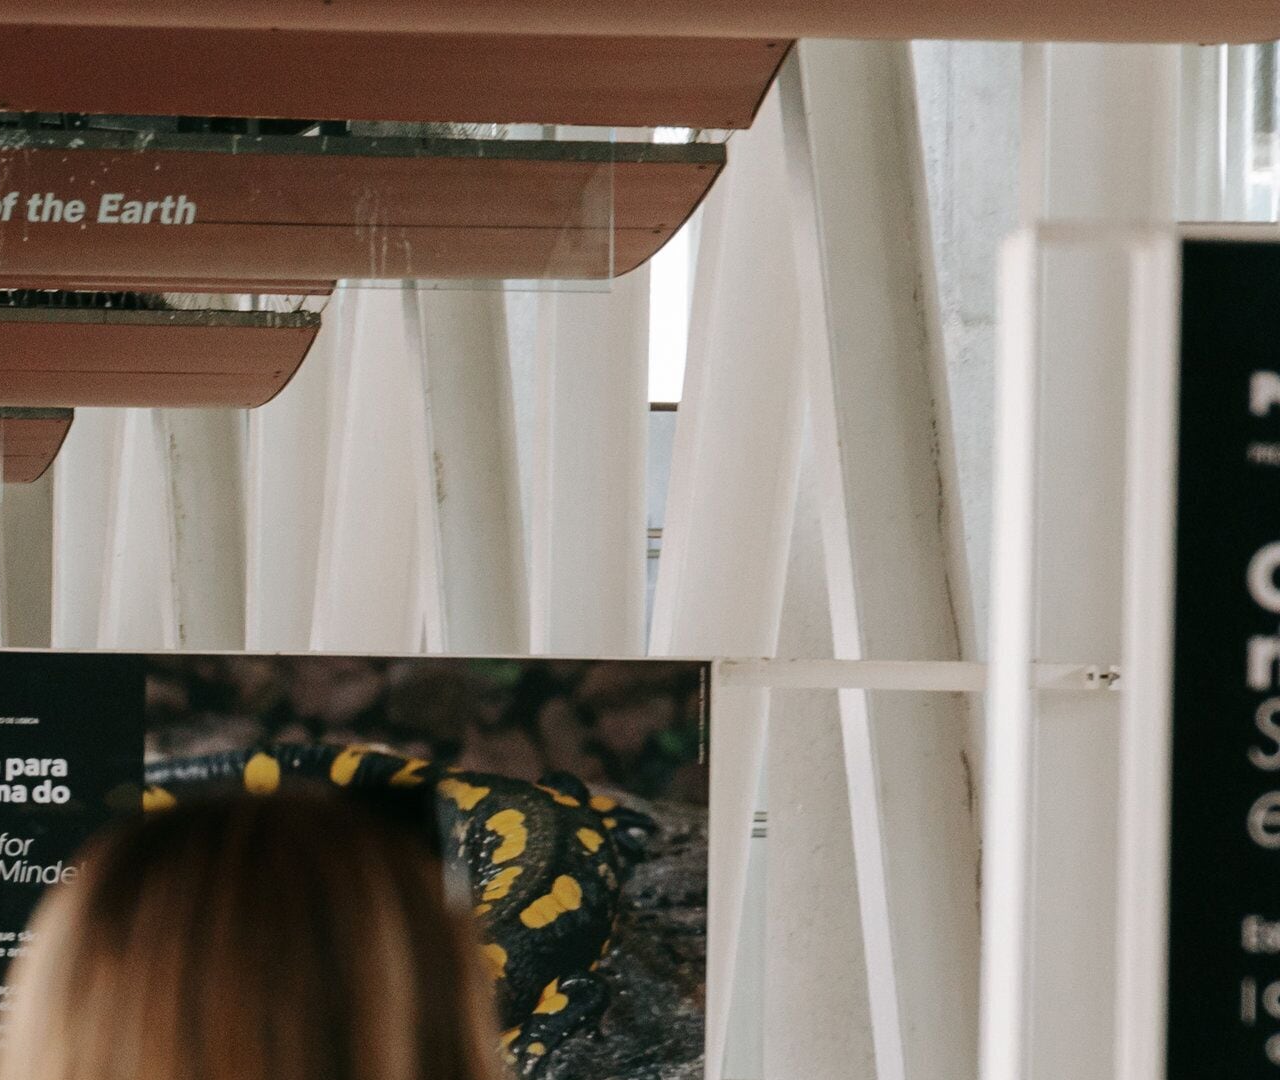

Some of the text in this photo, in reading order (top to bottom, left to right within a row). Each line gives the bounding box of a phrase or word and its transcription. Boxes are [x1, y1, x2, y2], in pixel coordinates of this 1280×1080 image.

[26, 190, 85, 222] the
[97, 191, 195, 224] Earth
[5, 758, 67, 782] para
[31, 781, 70, 804] do
